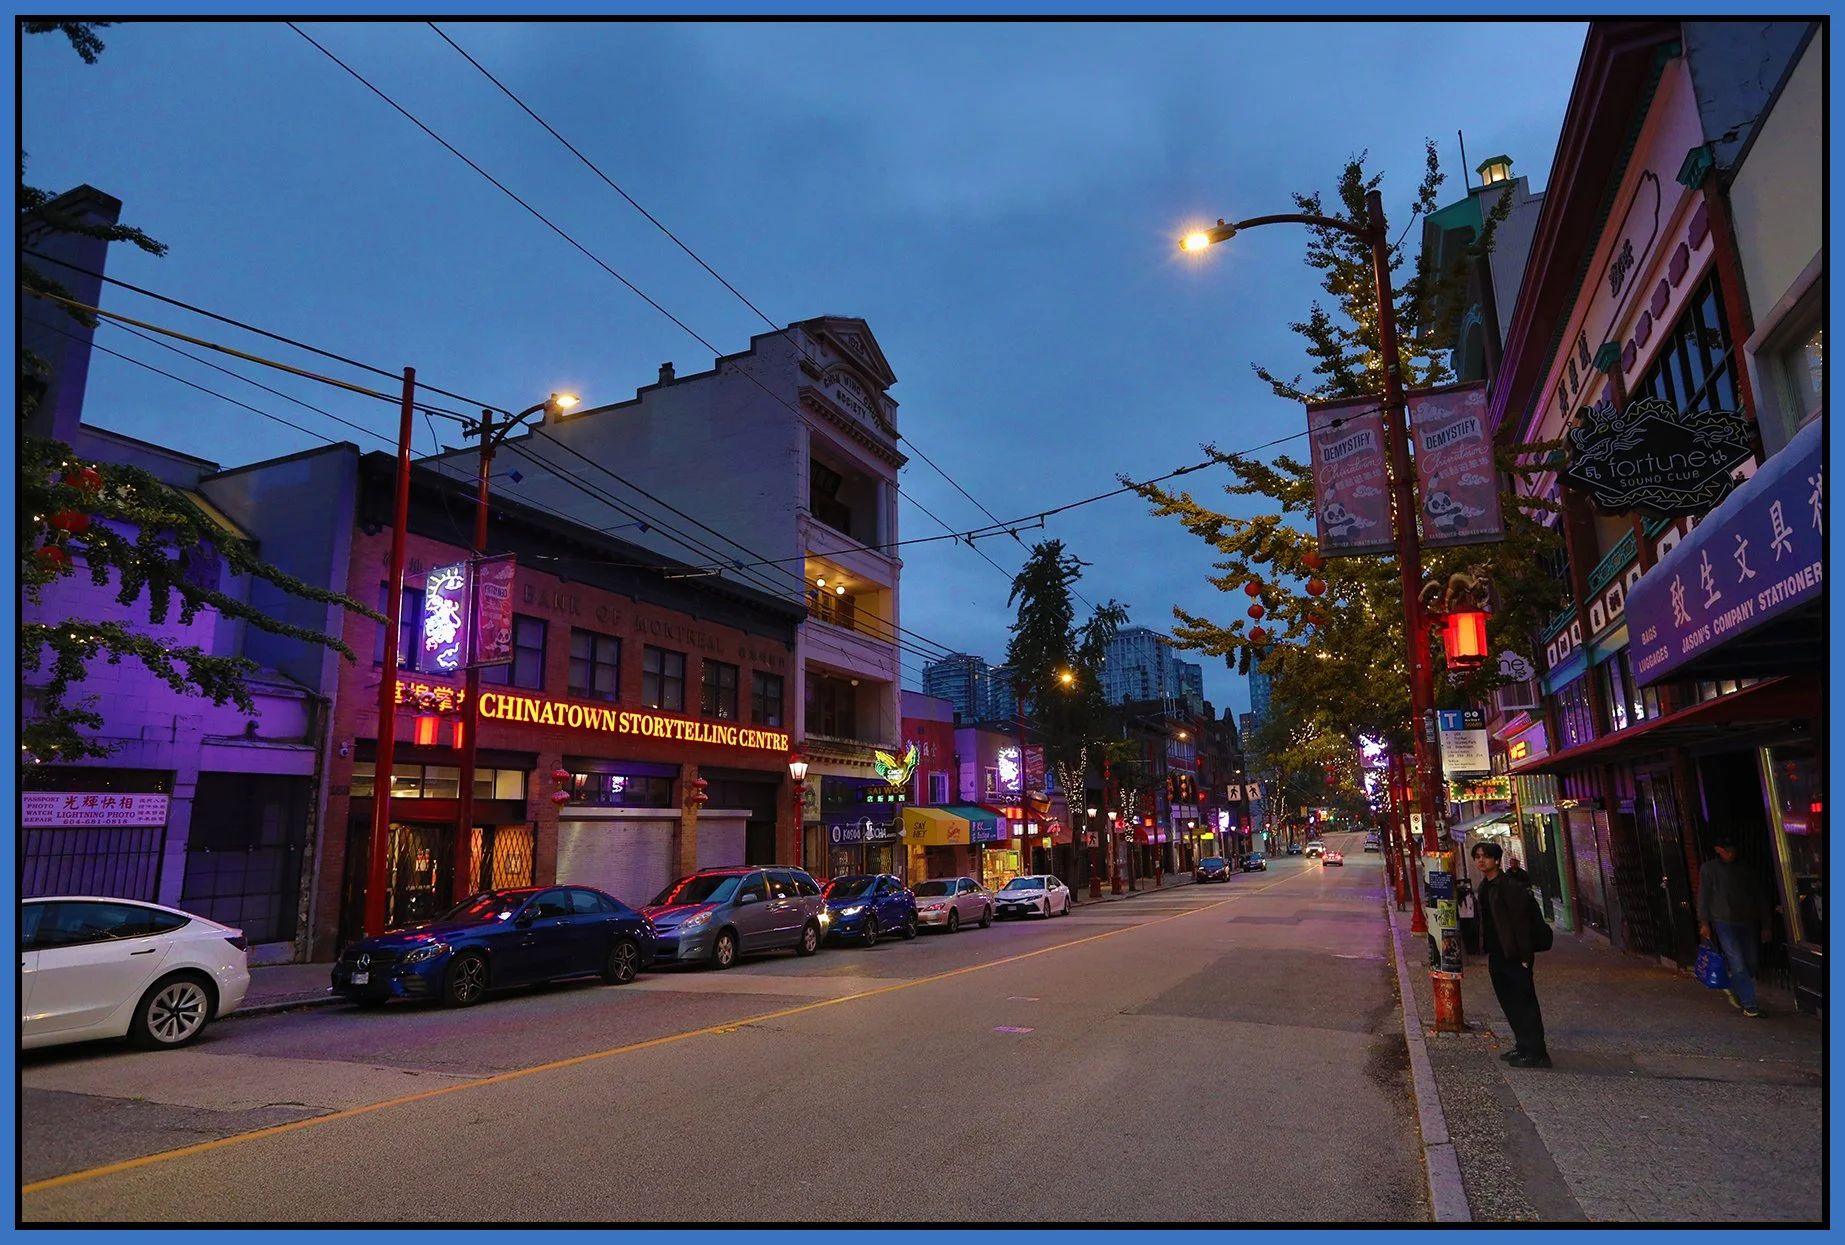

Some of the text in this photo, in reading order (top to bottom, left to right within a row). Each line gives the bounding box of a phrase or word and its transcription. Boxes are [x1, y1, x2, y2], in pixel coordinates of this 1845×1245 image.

[844, 375, 861, 395] WING
[837, 390, 866, 418] SOCIETY
[1324, 431, 1371, 461] DEMYSTIFY
[1426, 419, 1476, 450] DEMYSTIFY
[1319, 457, 1383, 485] Chinatown
[1421, 444, 1489, 474] Chinatown
[1608, 450, 1707, 478] fortune
[1620, 470, 1700, 488] SOUND CLUB
[523, 583, 725, 654] BANK OF MONTREAL
[1682, 625, 1711, 653] JASON'S
[1713, 599, 1755, 635] COMPANY
[1641, 625, 1657, 646] BAGS
[1638, 645, 1669, 673] LUGGAGES
[479, 692, 789, 752] CHINATOWN STORYTELLING CENTRE
[63, 795, 133, 810] 光輝快相
[867, 786, 906, 795] SAI WOO
[914, 821, 926, 830] SAY
